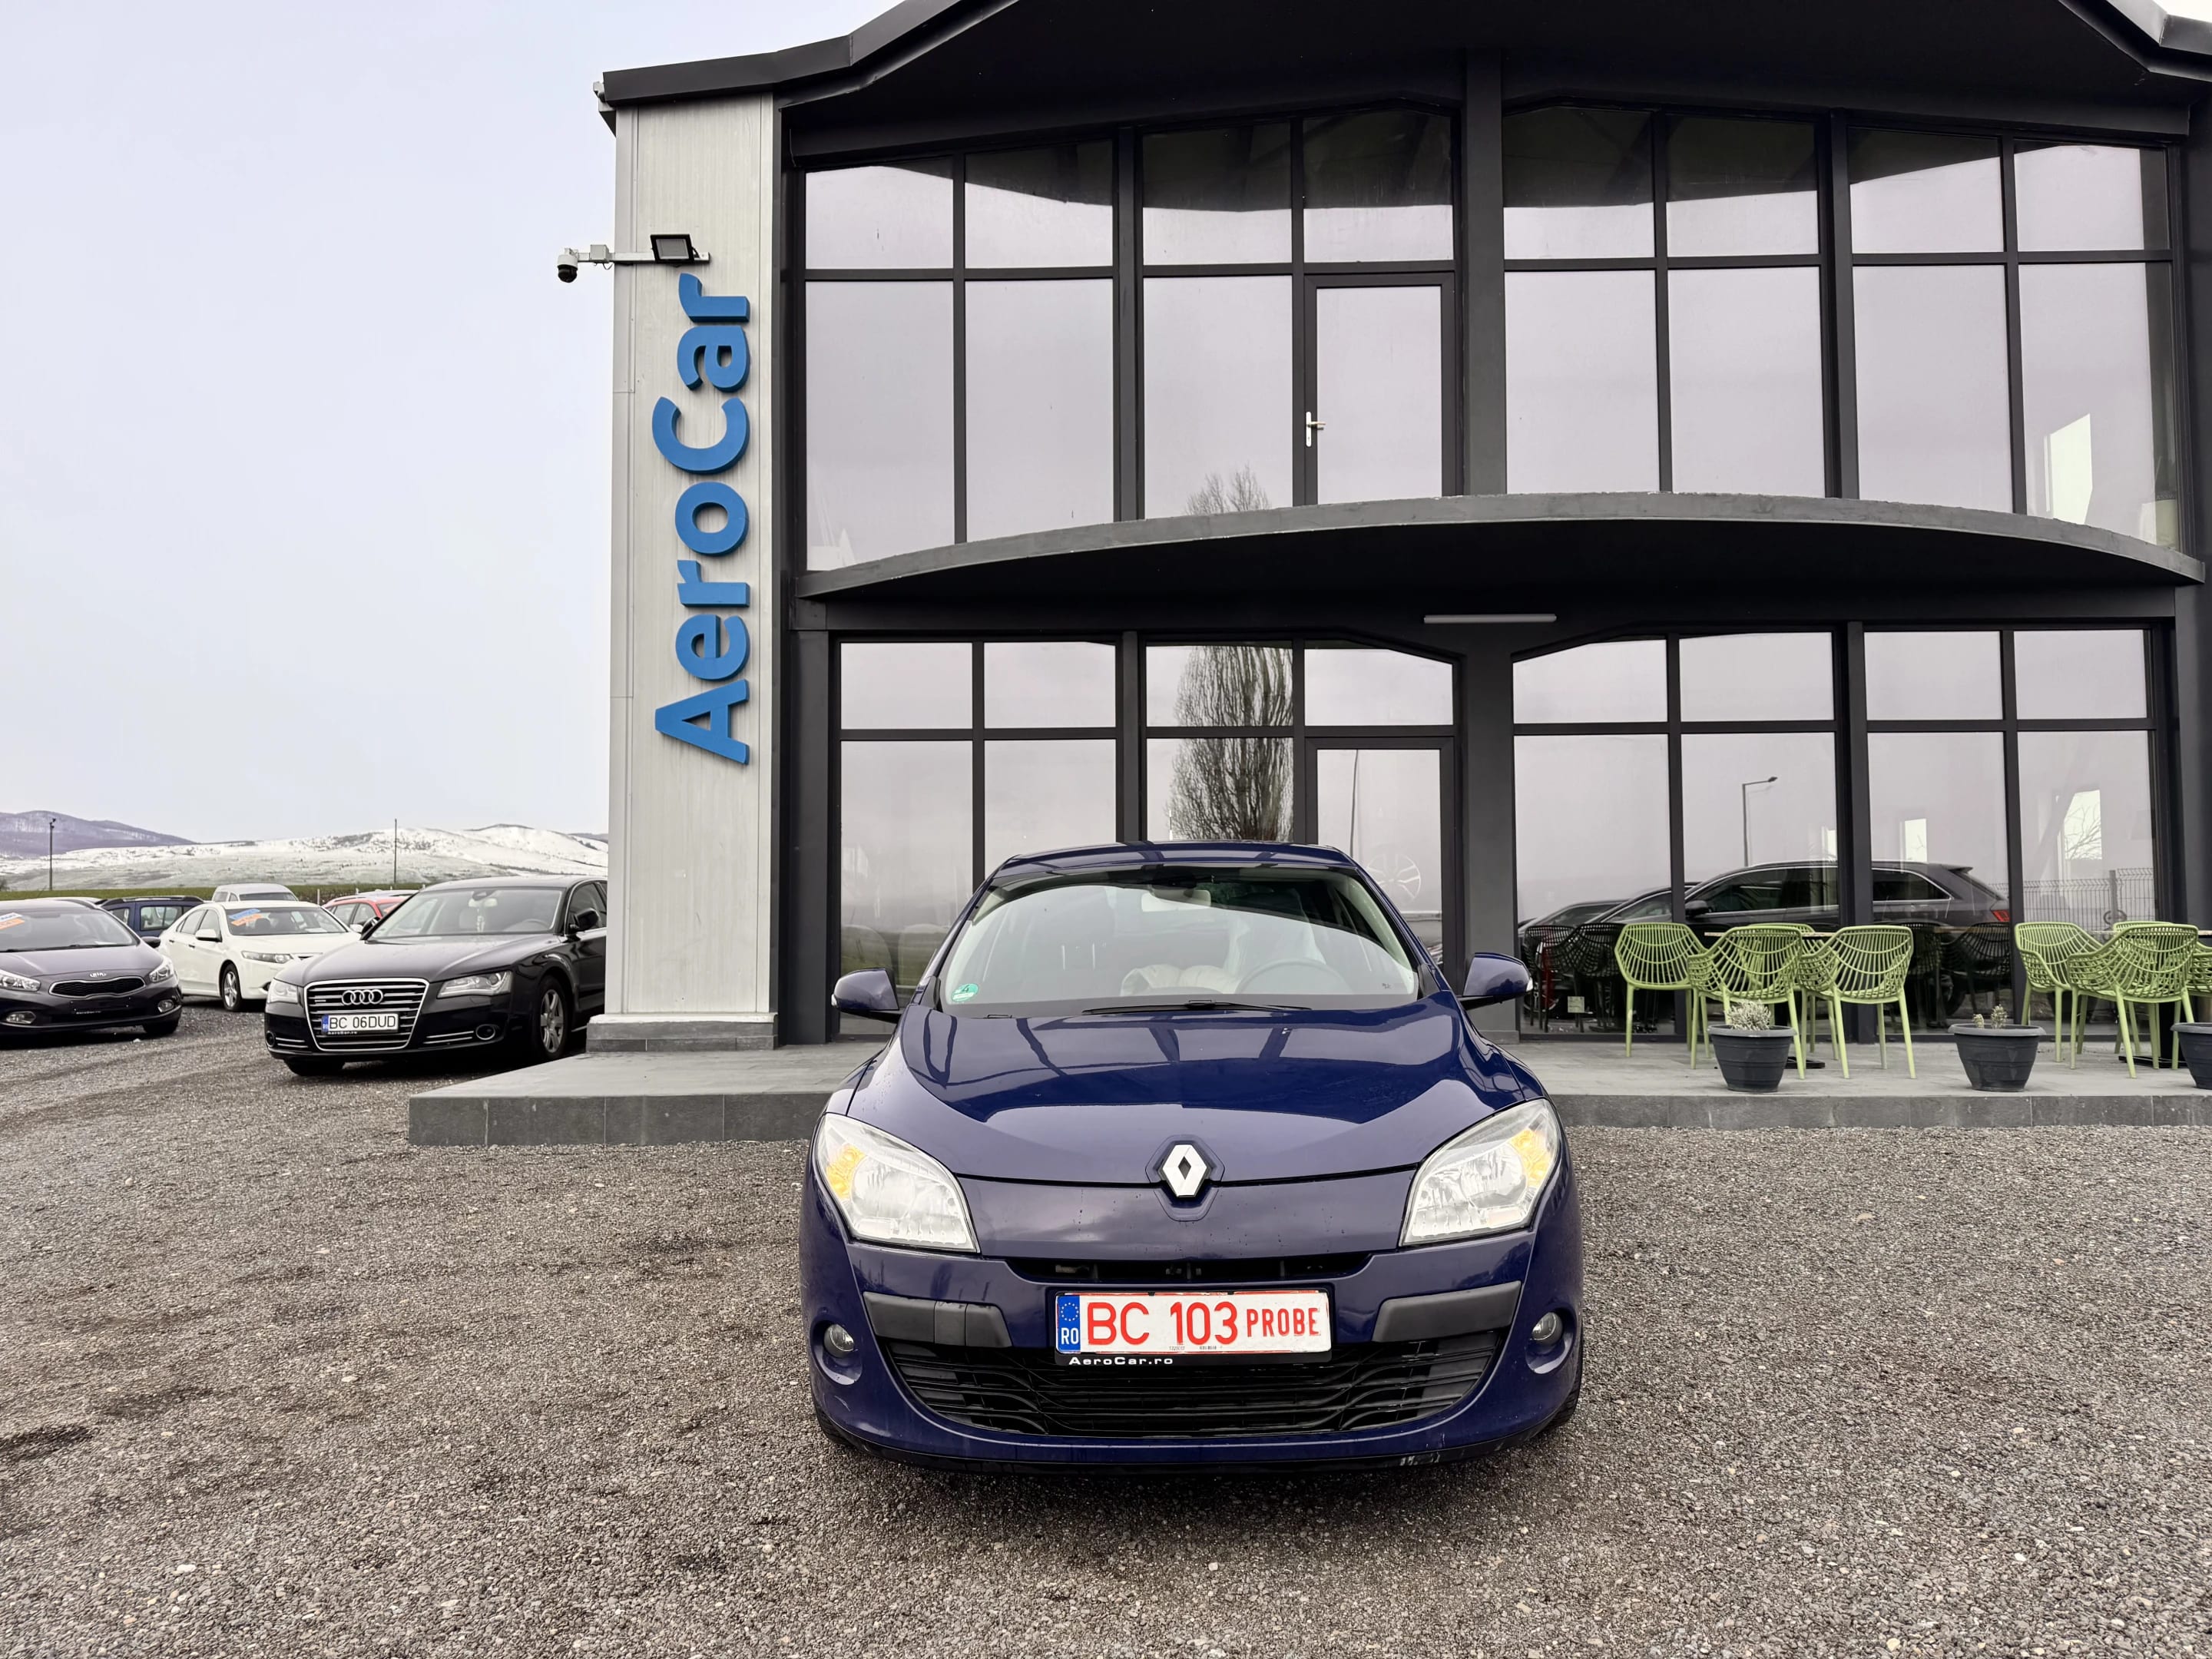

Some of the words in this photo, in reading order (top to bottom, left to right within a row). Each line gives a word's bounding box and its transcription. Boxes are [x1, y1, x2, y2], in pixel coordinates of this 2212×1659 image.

[651, 273, 750, 765] AeroCar
[329, 1017, 347, 1029] BC
[353, 1015, 396, 1028] 06DUD
[1061, 1327, 1079, 1345] RO
[1088, 1302, 1150, 1346] BC
[1170, 1301, 1238, 1346] 103
[1247, 1308, 1320, 1337] PROBE
[1068, 1356, 1174, 1366] AeroCar.ro
